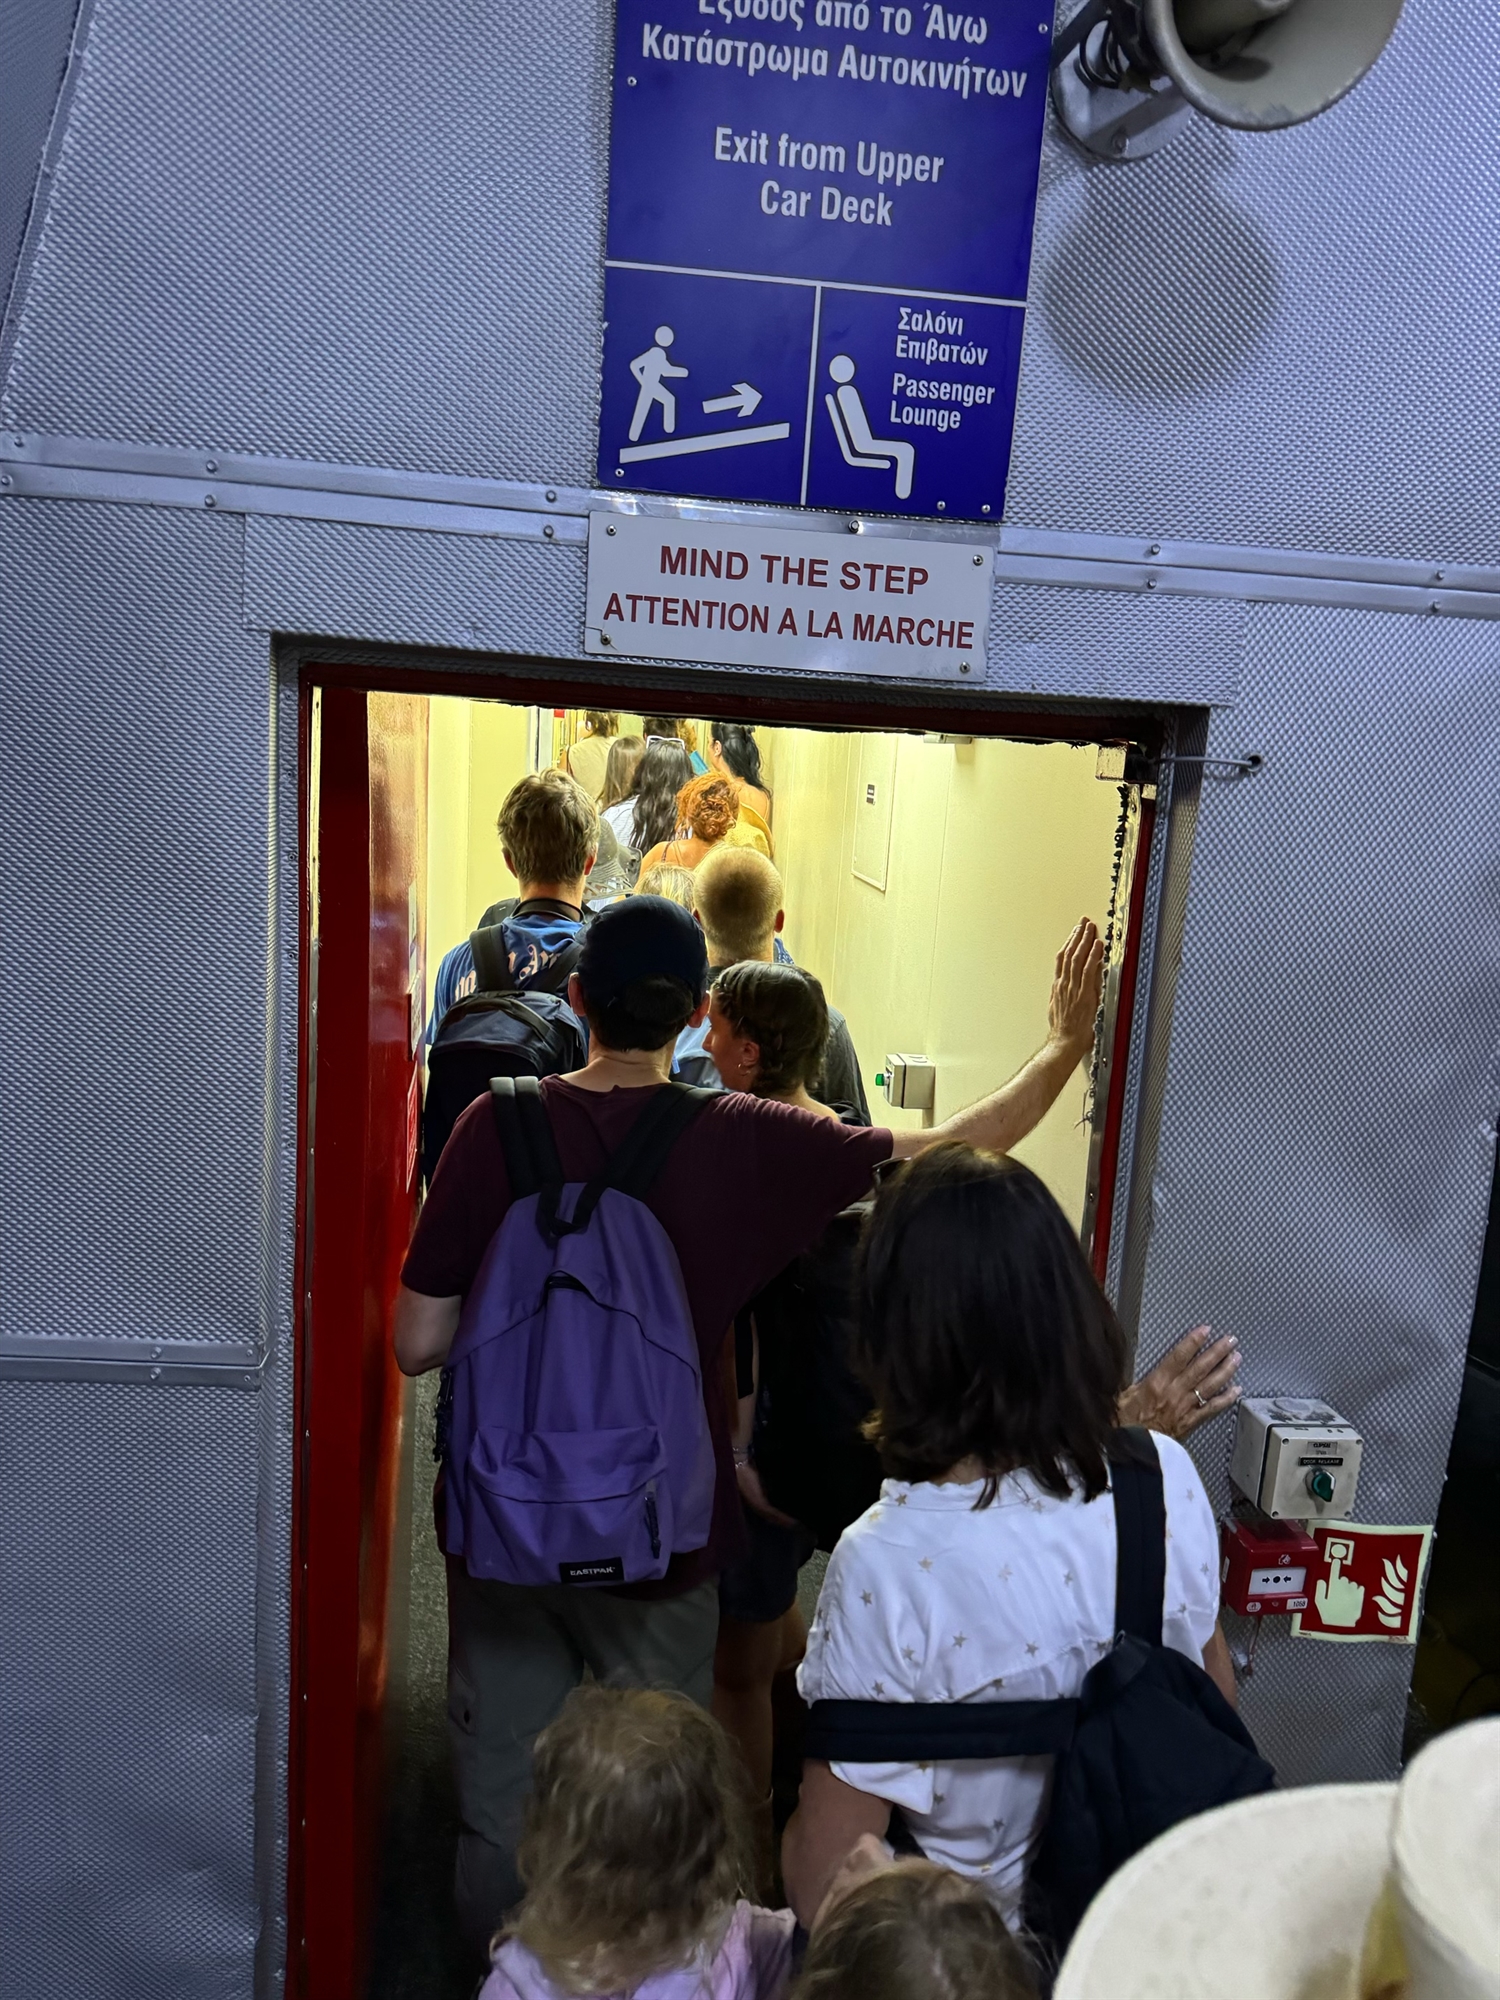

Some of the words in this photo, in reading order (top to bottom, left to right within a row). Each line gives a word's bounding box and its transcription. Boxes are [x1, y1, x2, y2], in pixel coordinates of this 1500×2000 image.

[815, 0, 870, 31] από
[880, 6, 912, 35] το
[923, 3, 987, 44] Άνω
[642, 23, 828, 81] Κατάστρωμα
[837, 44, 1027, 99] Αυτοκινήτων
[714, 126, 769, 166] Exit
[778, 133, 846, 173] from
[856, 140, 944, 187] Upper
[760, 180, 812, 217] Car
[820, 186, 893, 226] Deck
[897, 306, 963, 336] Σαλόνι
[895, 334, 988, 366] Επιβατών
[892, 372, 996, 407] Passenger
[890, 400, 961, 432] Lounge
[660, 545, 749, 580] MIND
[760, 553, 829, 588] THE
[839, 561, 929, 595] STEP
[603, 592, 769, 634] ATTENTION
[777, 607, 798, 636] A
[807, 609, 843, 640] LA
[852, 613, 975, 650] MARCHE
[569, 1566, 614, 1576] EASTPAK
